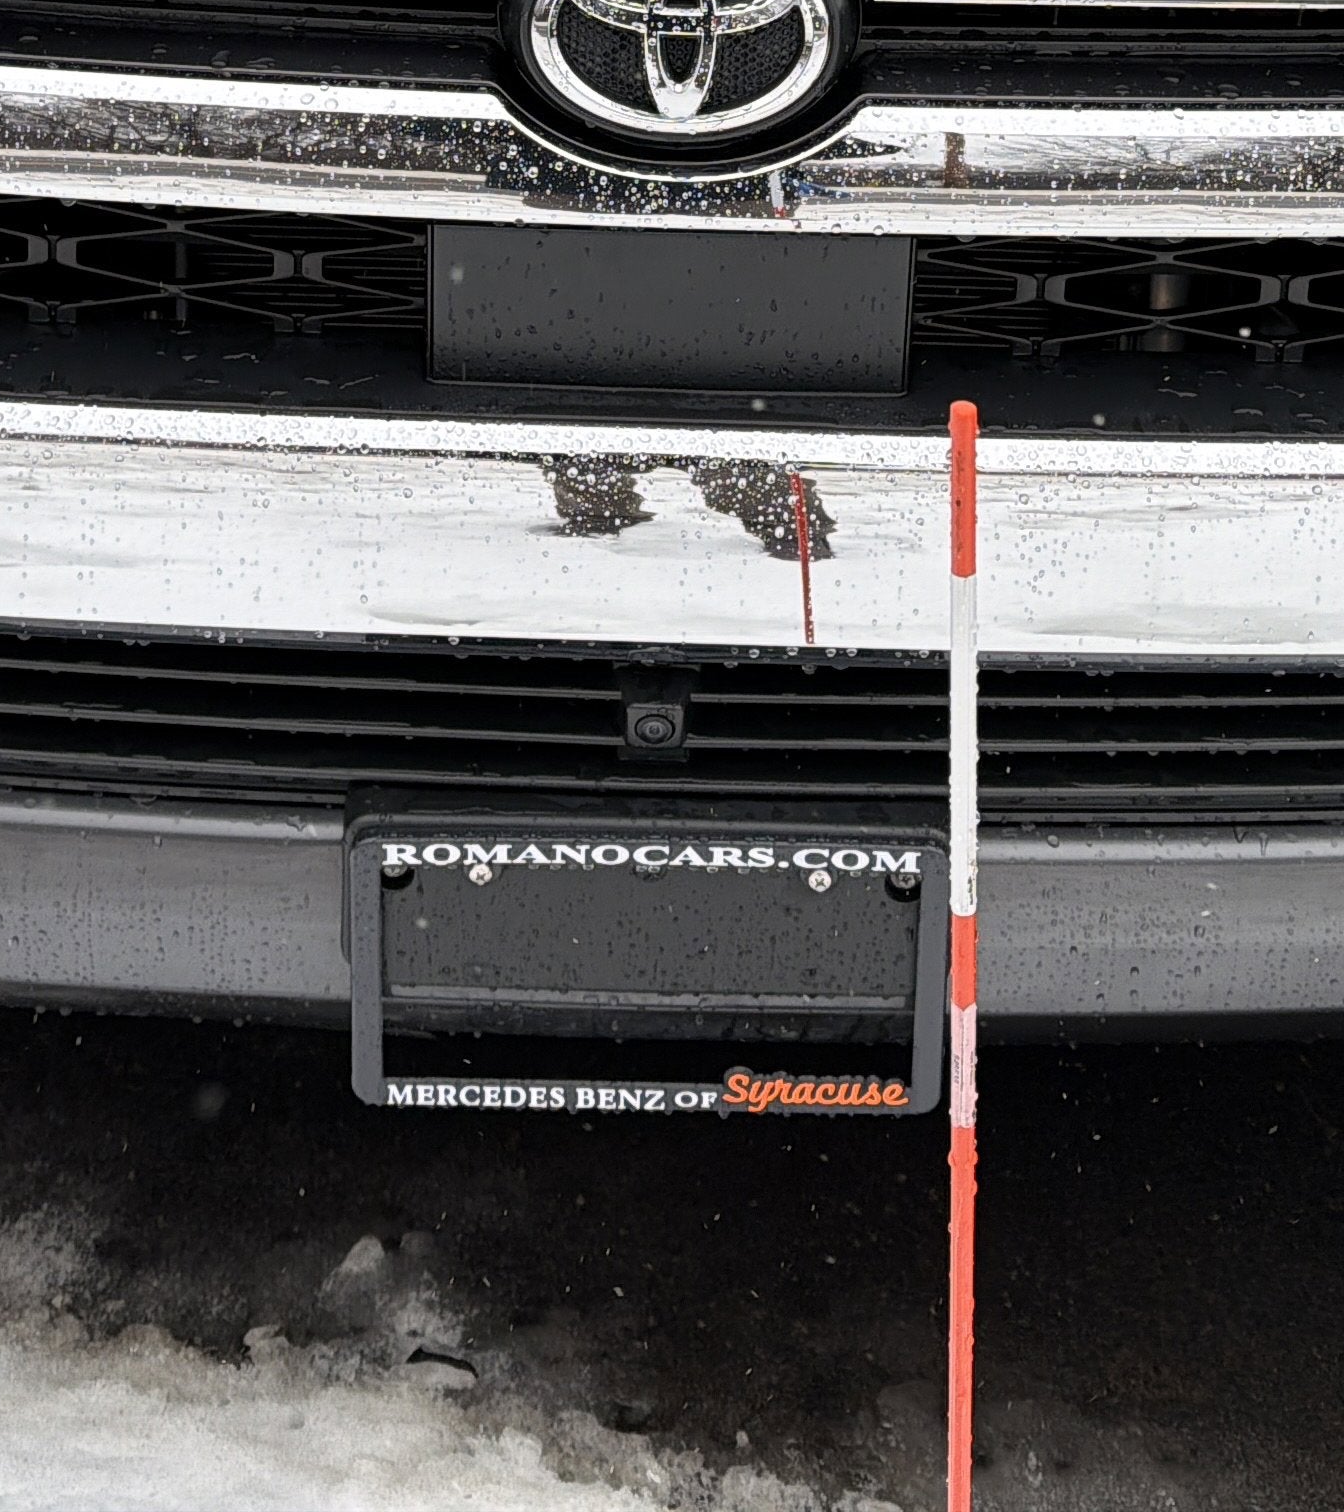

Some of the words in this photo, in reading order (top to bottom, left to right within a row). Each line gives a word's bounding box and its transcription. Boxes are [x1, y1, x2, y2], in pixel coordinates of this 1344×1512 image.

[381, 843, 922, 874] ROMANOCARS.COM
[387, 1083, 566, 1109] MERCEDES
[575, 1087, 666, 1111] BENZ
[674, 1090, 718, 1109] OF
[722, 1073, 909, 1113] Syracuse
